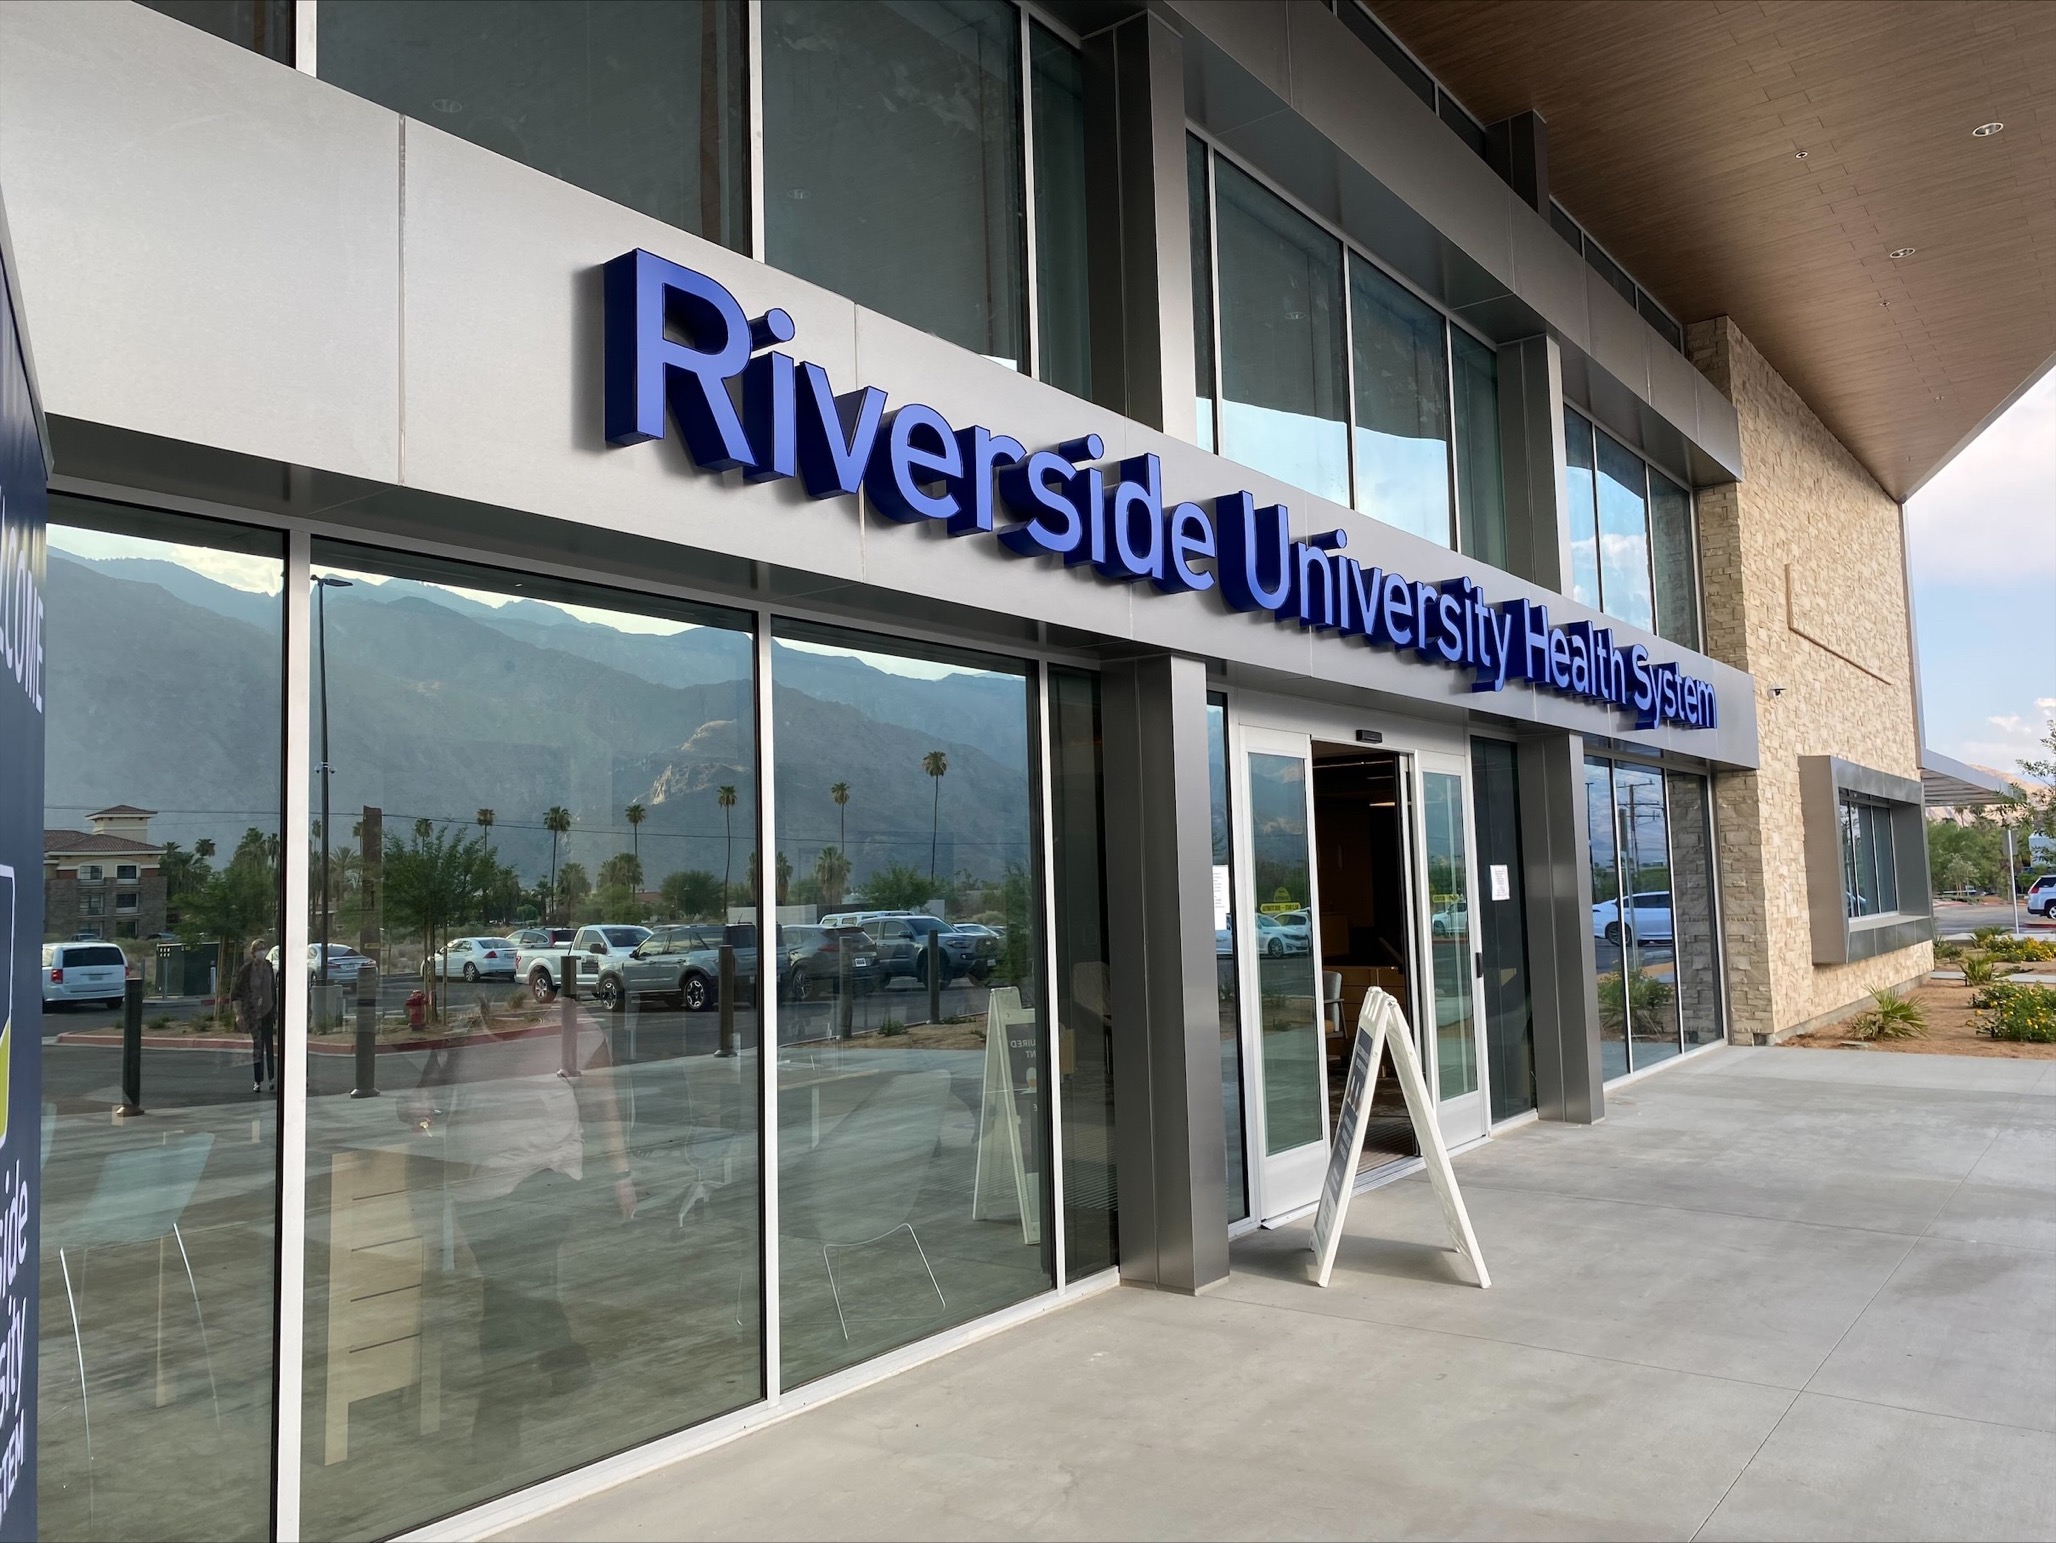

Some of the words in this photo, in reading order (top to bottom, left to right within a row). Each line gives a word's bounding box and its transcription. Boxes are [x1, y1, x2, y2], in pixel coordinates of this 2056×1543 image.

[0, 485, 44, 714] LCOME
[604, 247, 1216, 594] Riverside
[1215, 490, 1512, 693] University
[1502, 598, 1627, 705] Health
[1624, 644, 1718, 731] System
[0, 1408, 25, 1528] TEM
